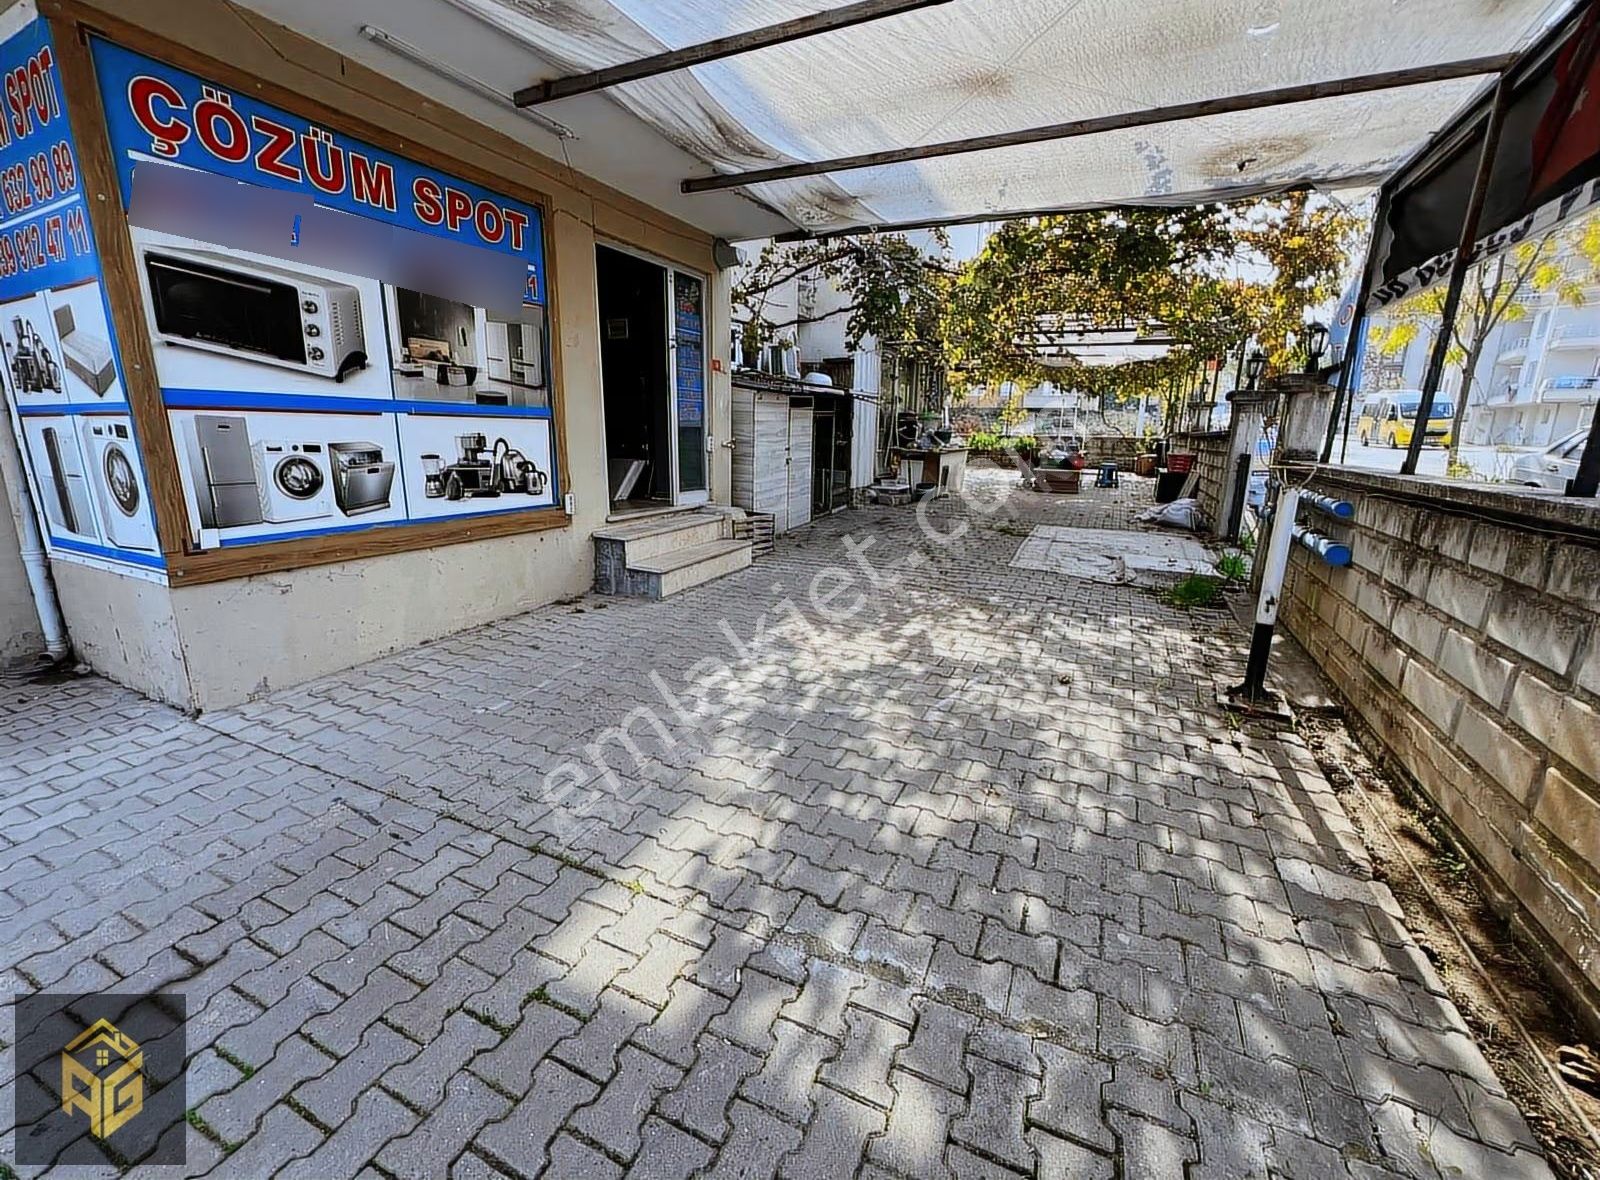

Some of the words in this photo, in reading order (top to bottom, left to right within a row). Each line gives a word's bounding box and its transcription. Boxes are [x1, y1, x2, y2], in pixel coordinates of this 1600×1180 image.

[5, 45, 60, 139] SPOT
[1, 163, 32, 214] 632
[29, 152, 53, 203] 98
[51, 140, 76, 199] 89
[127, 75, 397, 212] ÇÖZÜM
[412, 177, 529, 250] SPOT
[14, 223, 47, 272] 912
[46, 215, 65, 262] 47
[67, 206, 90, 256] 11
